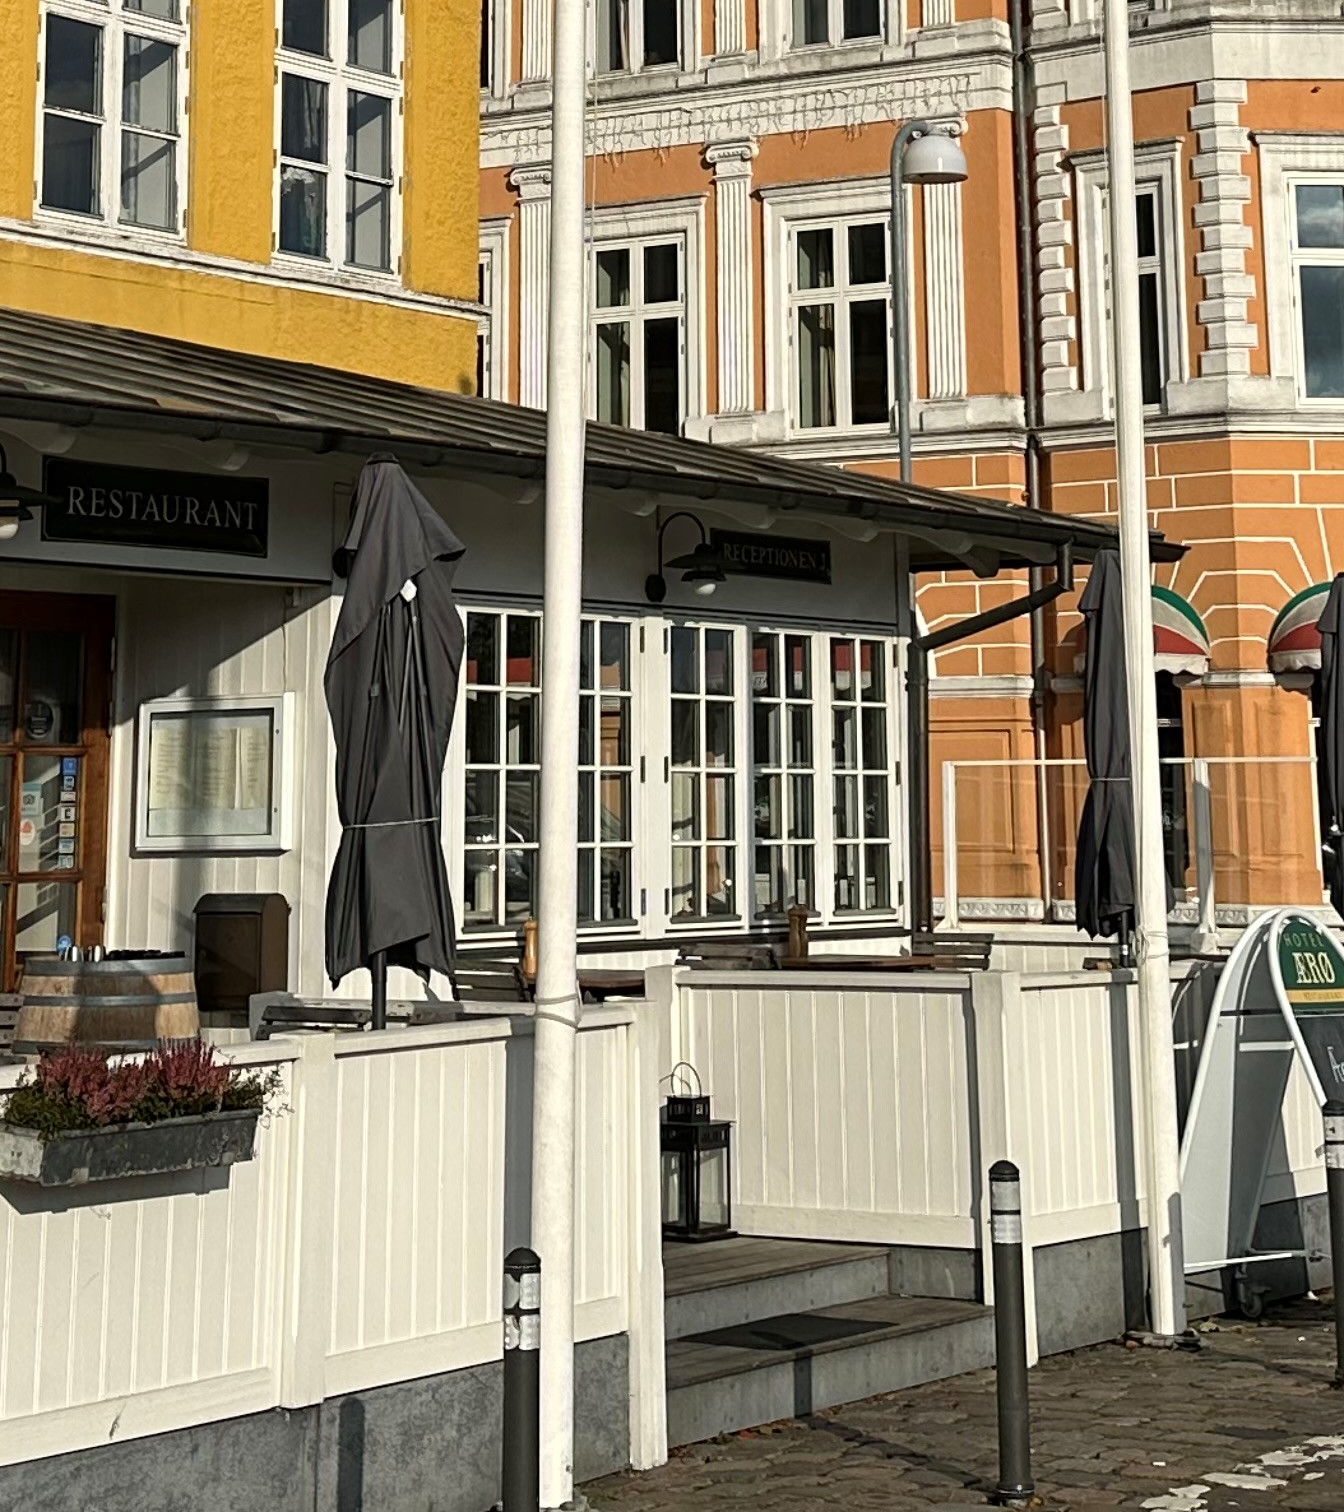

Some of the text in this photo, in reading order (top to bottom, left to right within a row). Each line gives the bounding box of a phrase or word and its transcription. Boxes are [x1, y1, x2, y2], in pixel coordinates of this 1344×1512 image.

[67, 486, 257, 530] RESTAURANT
[722, 542, 817, 568] RECEPTIONEN
[1282, 933, 1325, 947] HOTEL
[1292, 952, 1335, 983] ÆRØ
